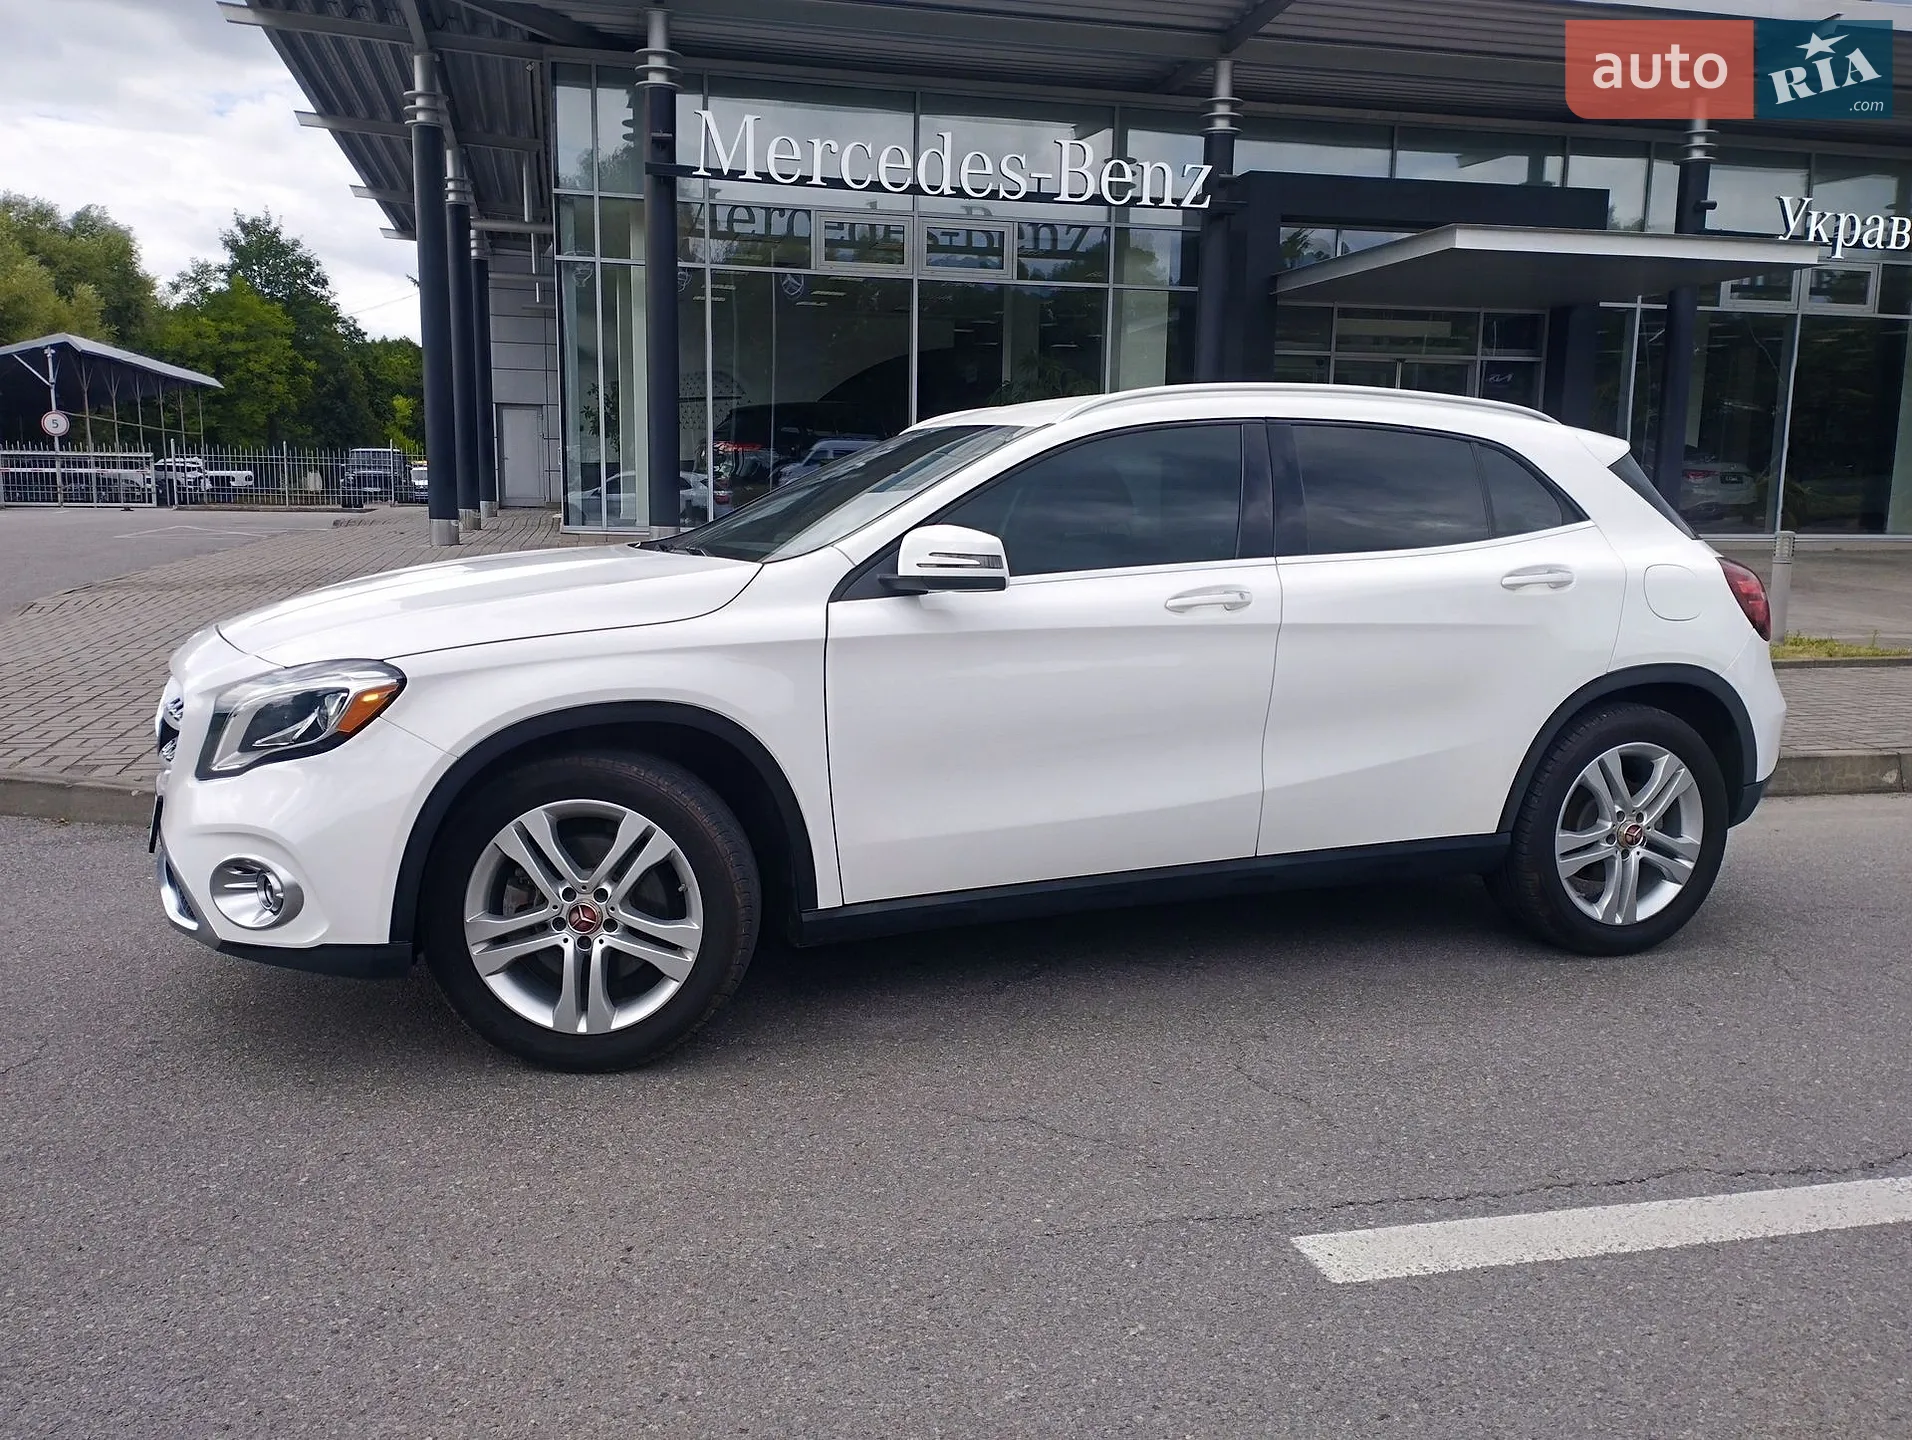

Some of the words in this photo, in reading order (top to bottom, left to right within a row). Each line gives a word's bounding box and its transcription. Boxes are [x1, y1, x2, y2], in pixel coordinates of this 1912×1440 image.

[693, 108, 1213, 209] Mercedes-Benz
[1778, 195, 1912, 259] Украв
[51, 419, 59, 429] 5
